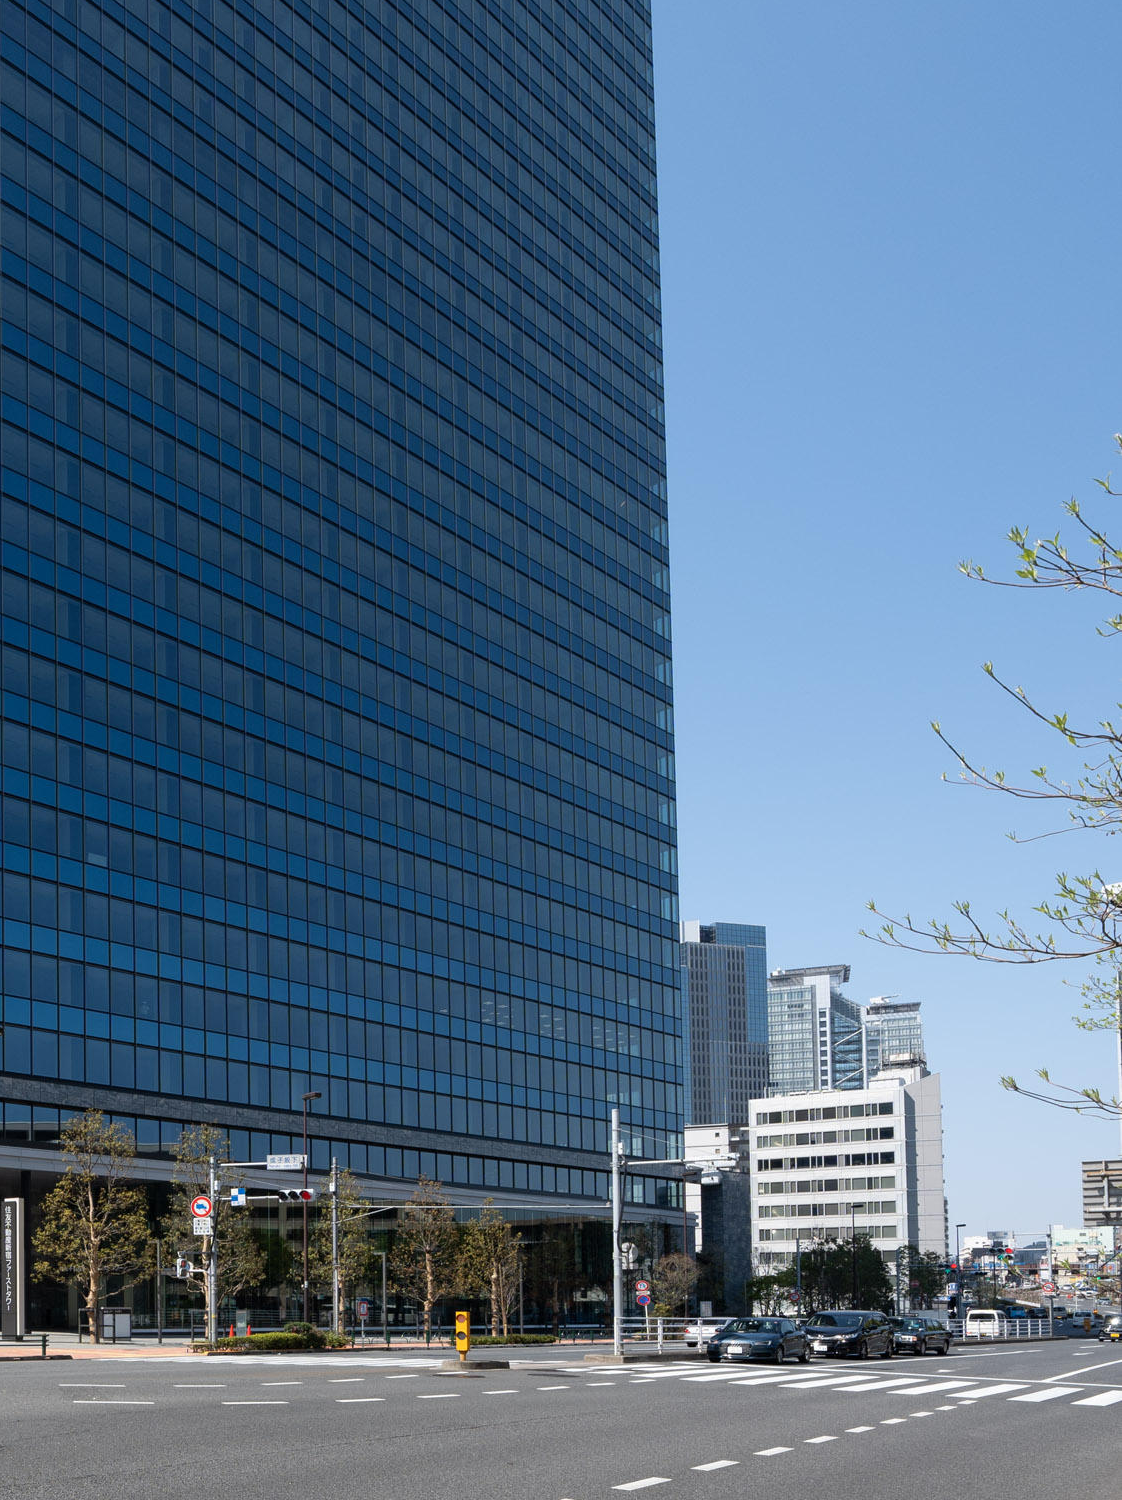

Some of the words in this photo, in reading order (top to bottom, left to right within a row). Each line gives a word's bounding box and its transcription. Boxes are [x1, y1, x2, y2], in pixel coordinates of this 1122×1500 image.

[4, 1205, 12, 1311] 住友不動産新宿ファーストタワー
